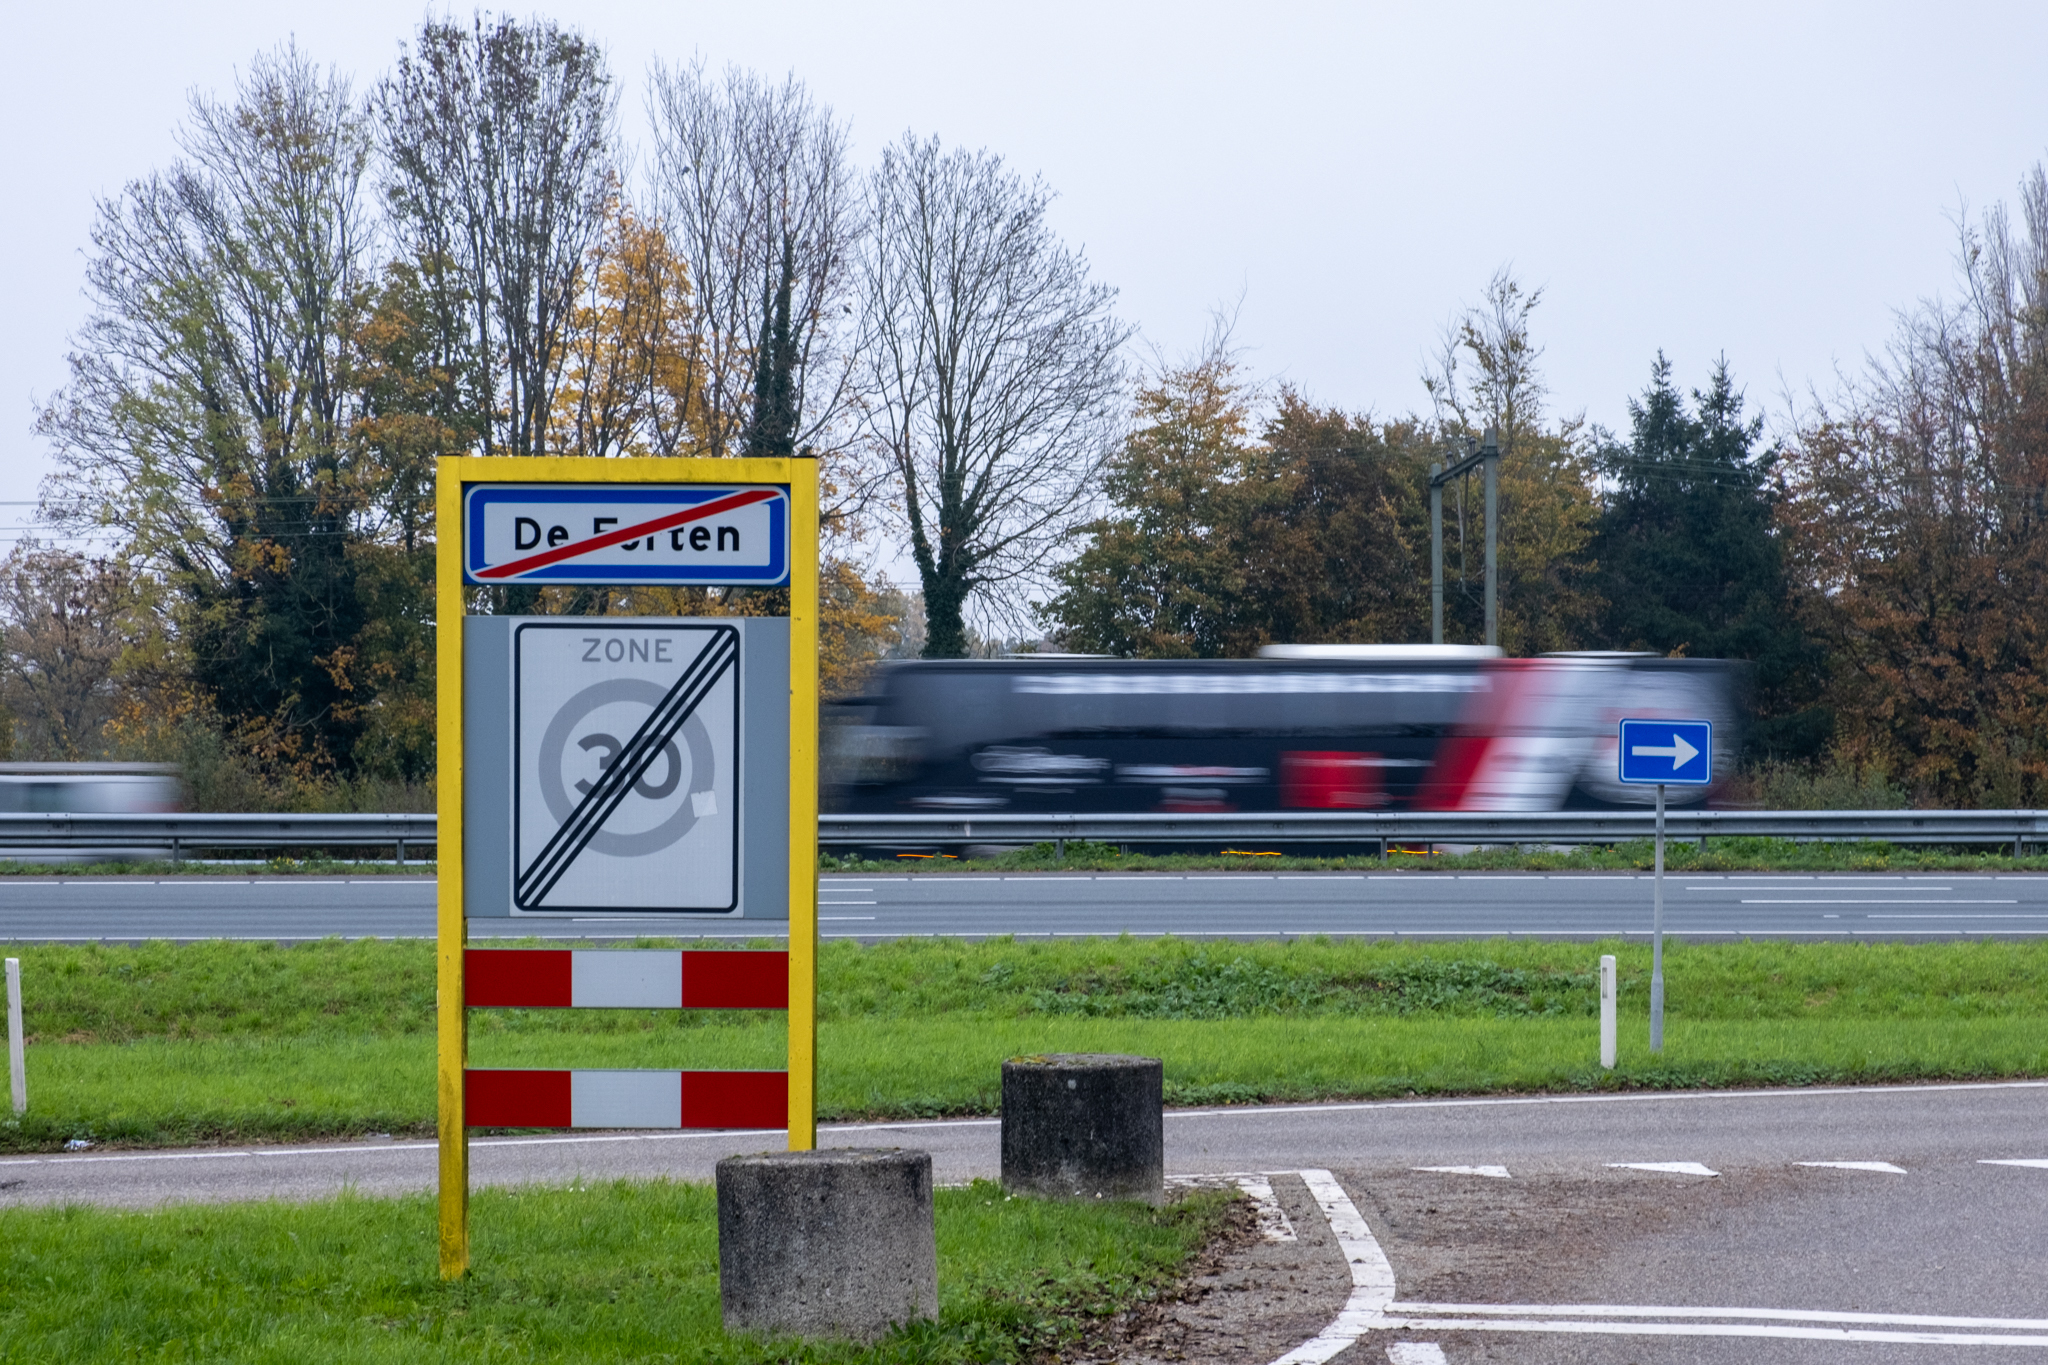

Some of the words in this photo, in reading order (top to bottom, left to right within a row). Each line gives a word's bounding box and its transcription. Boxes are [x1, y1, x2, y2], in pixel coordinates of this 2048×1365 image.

[515, 517, 569, 551] De
[582, 638, 673, 663] ZONE
[574, 732, 682, 800] 30
